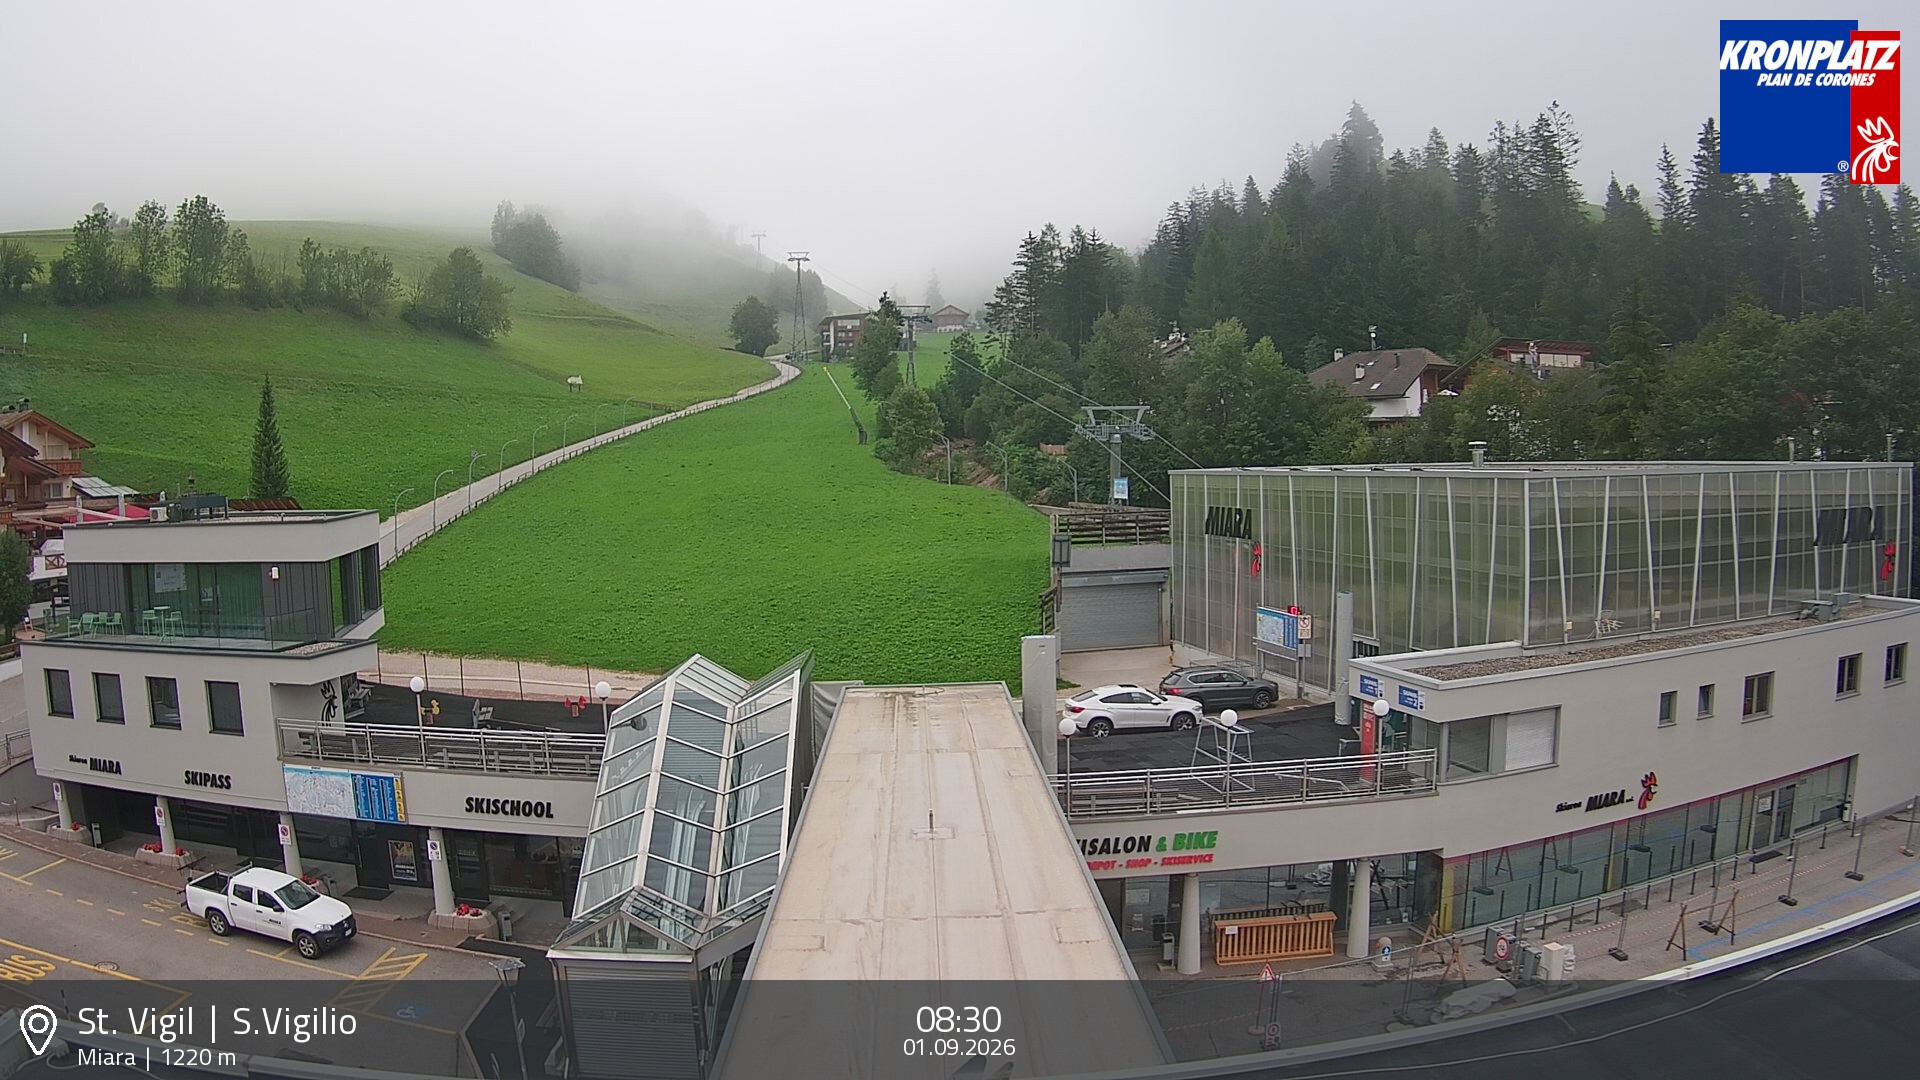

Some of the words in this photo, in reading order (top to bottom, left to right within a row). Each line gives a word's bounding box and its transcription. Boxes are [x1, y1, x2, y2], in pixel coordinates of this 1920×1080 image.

[1205, 506, 1253, 540] MIARA
[89, 757, 122, 775] MIARA
[184, 770, 232, 790] SKIPASS
[465, 797, 554, 818] SKISCHOOL
[1584, 789, 1626, 812] MIARA
[1077, 835, 1152, 856] ISALON
[1155, 836, 1167, 852] &
[1172, 830, 1218, 851] BIKE
[1125, 858, 1152, 869] SHOP
[1160, 854, 1214, 866] SKISERVICE
